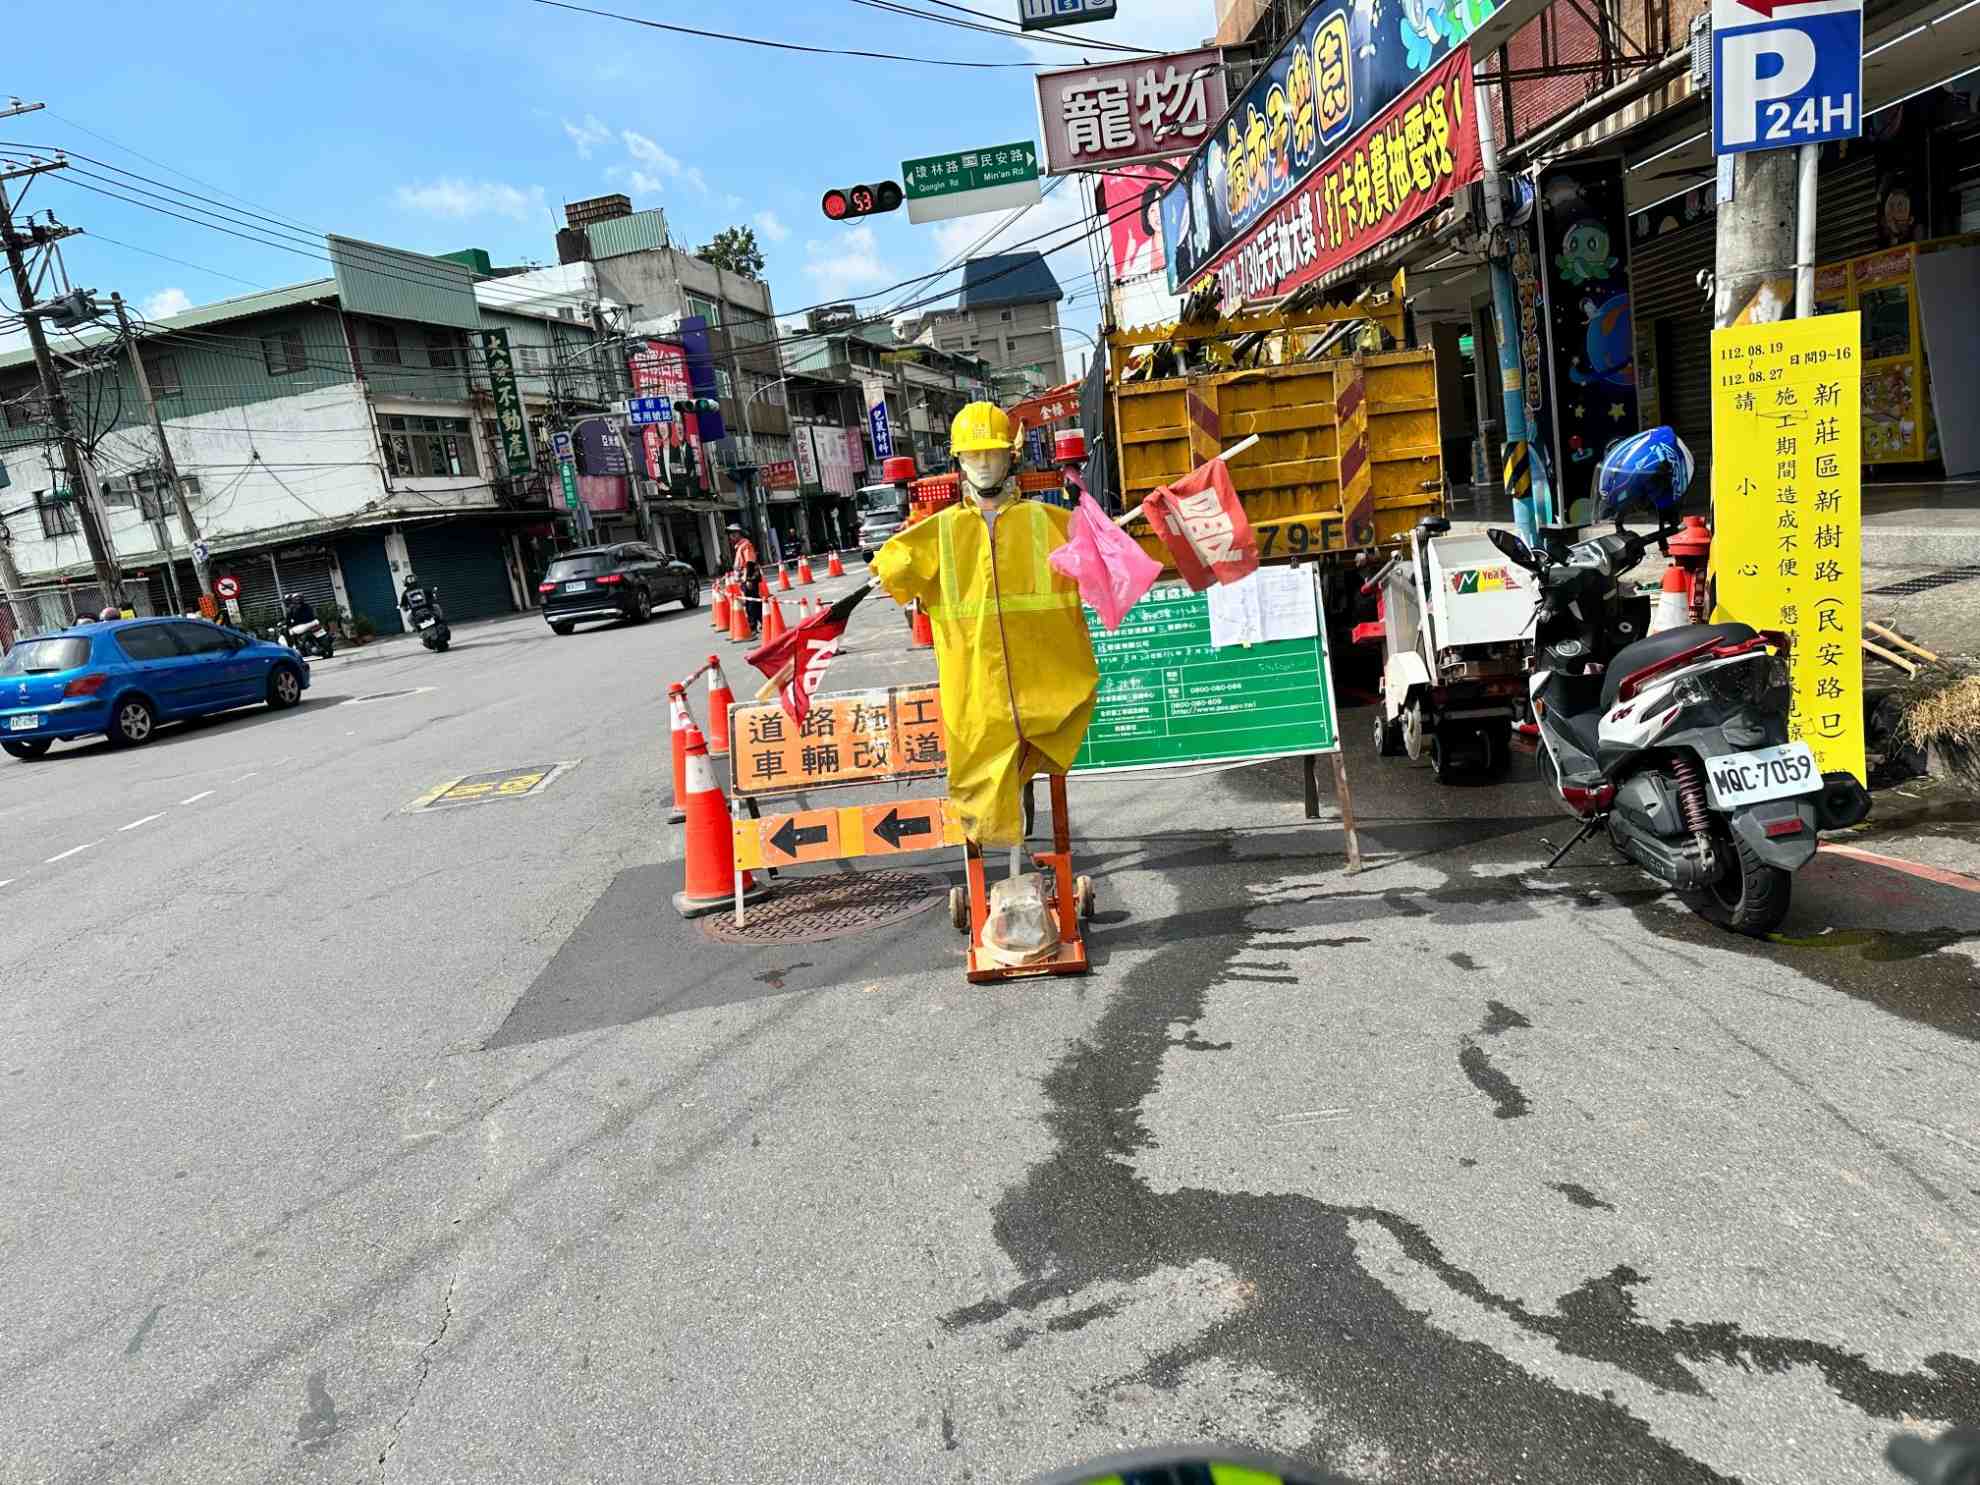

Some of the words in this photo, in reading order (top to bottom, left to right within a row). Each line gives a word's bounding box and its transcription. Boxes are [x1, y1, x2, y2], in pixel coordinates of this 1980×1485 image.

[1062, 64, 1207, 156] 寵物
[1722, 28, 1816, 146] P
[1765, 93, 1853, 140] 24H
[981, 149, 1022, 167] 民安路
[1012, 167, 1024, 176] Rd
[852, 192, 872, 212] 53
[873, 410, 889, 453] 包裝材料
[1813, 382, 1846, 738] 新莊區新樹路（民安路口）
[749, 699, 938, 745] 道路施工
[751, 733, 946, 780] 車輛改道
